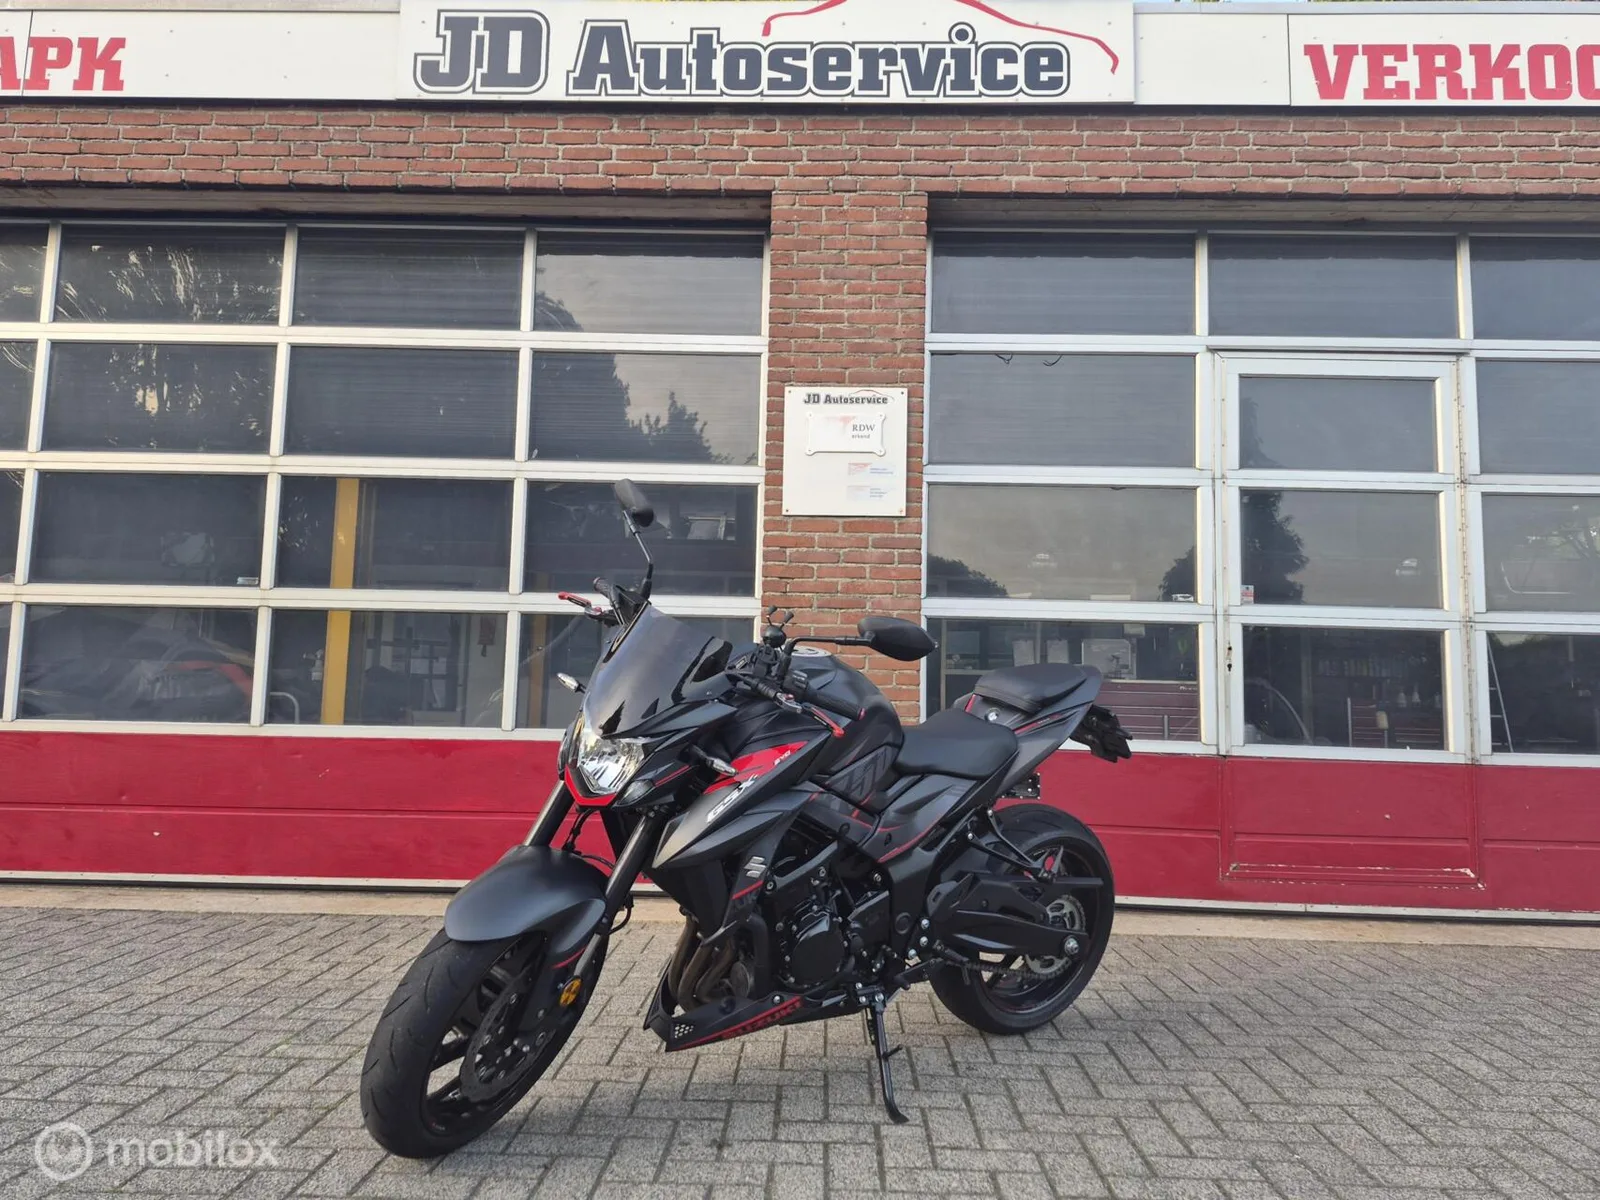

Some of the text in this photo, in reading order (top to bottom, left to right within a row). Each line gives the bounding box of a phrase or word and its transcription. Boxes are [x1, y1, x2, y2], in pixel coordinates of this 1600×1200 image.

[413, 9, 1071, 98] JD Autoservice
[804, 393, 888, 404] JD Autoservice
[852, 424, 876, 432] RDW
